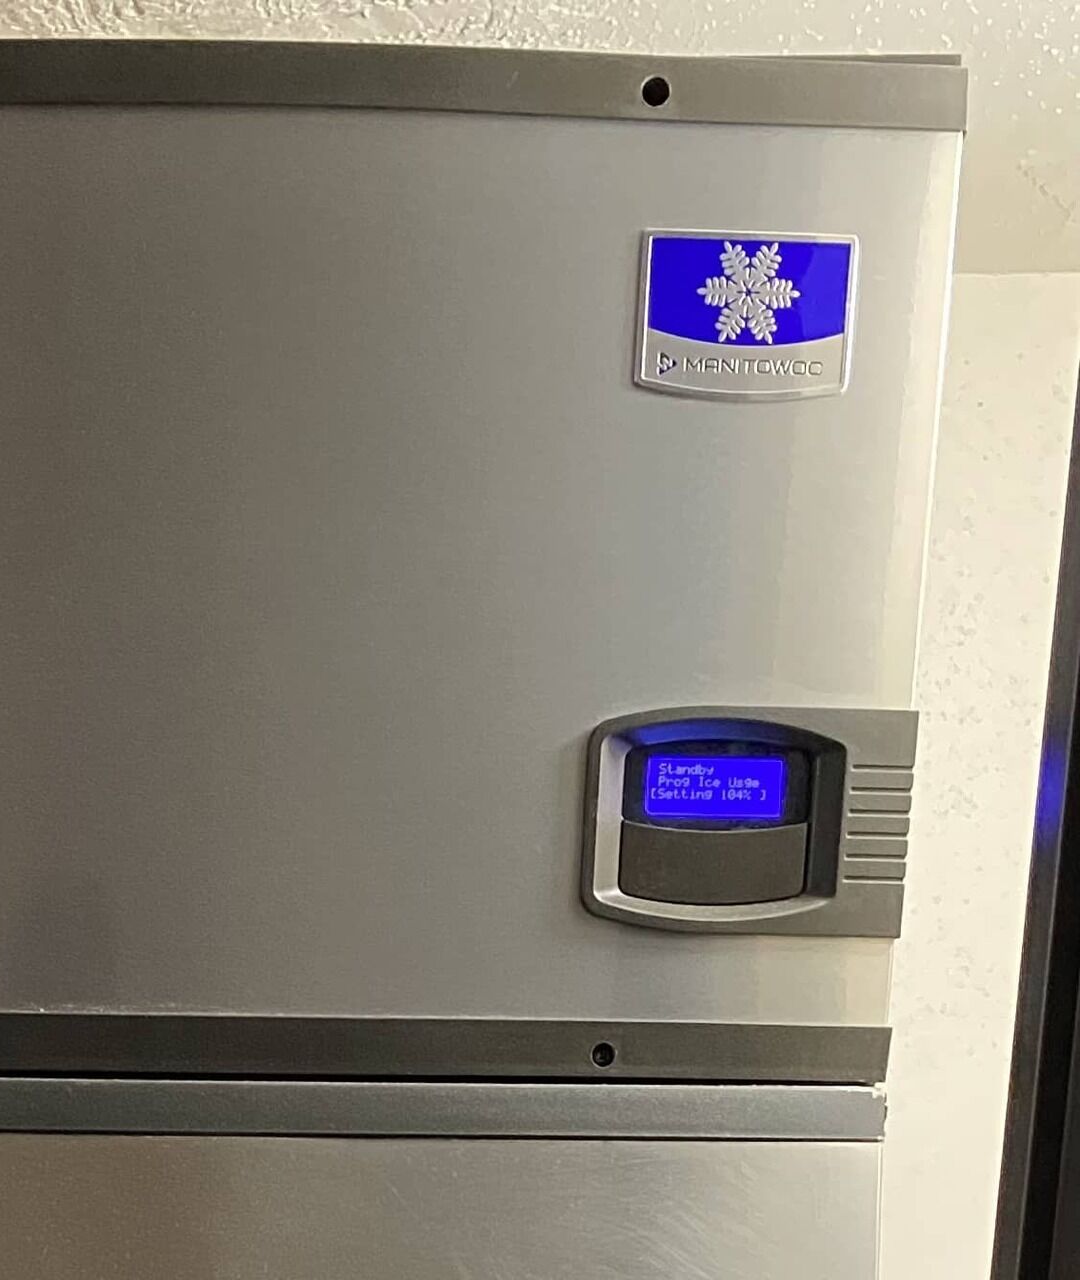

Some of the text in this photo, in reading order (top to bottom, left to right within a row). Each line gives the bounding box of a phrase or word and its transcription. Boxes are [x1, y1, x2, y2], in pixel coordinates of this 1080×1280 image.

[682, 357, 823, 376] MANITOWOC
[658, 763, 714, 776] Standby
[658, 776, 690, 788] Prog
[699, 777, 721, 788] Ice
[721, 789, 752, 801] 104%
